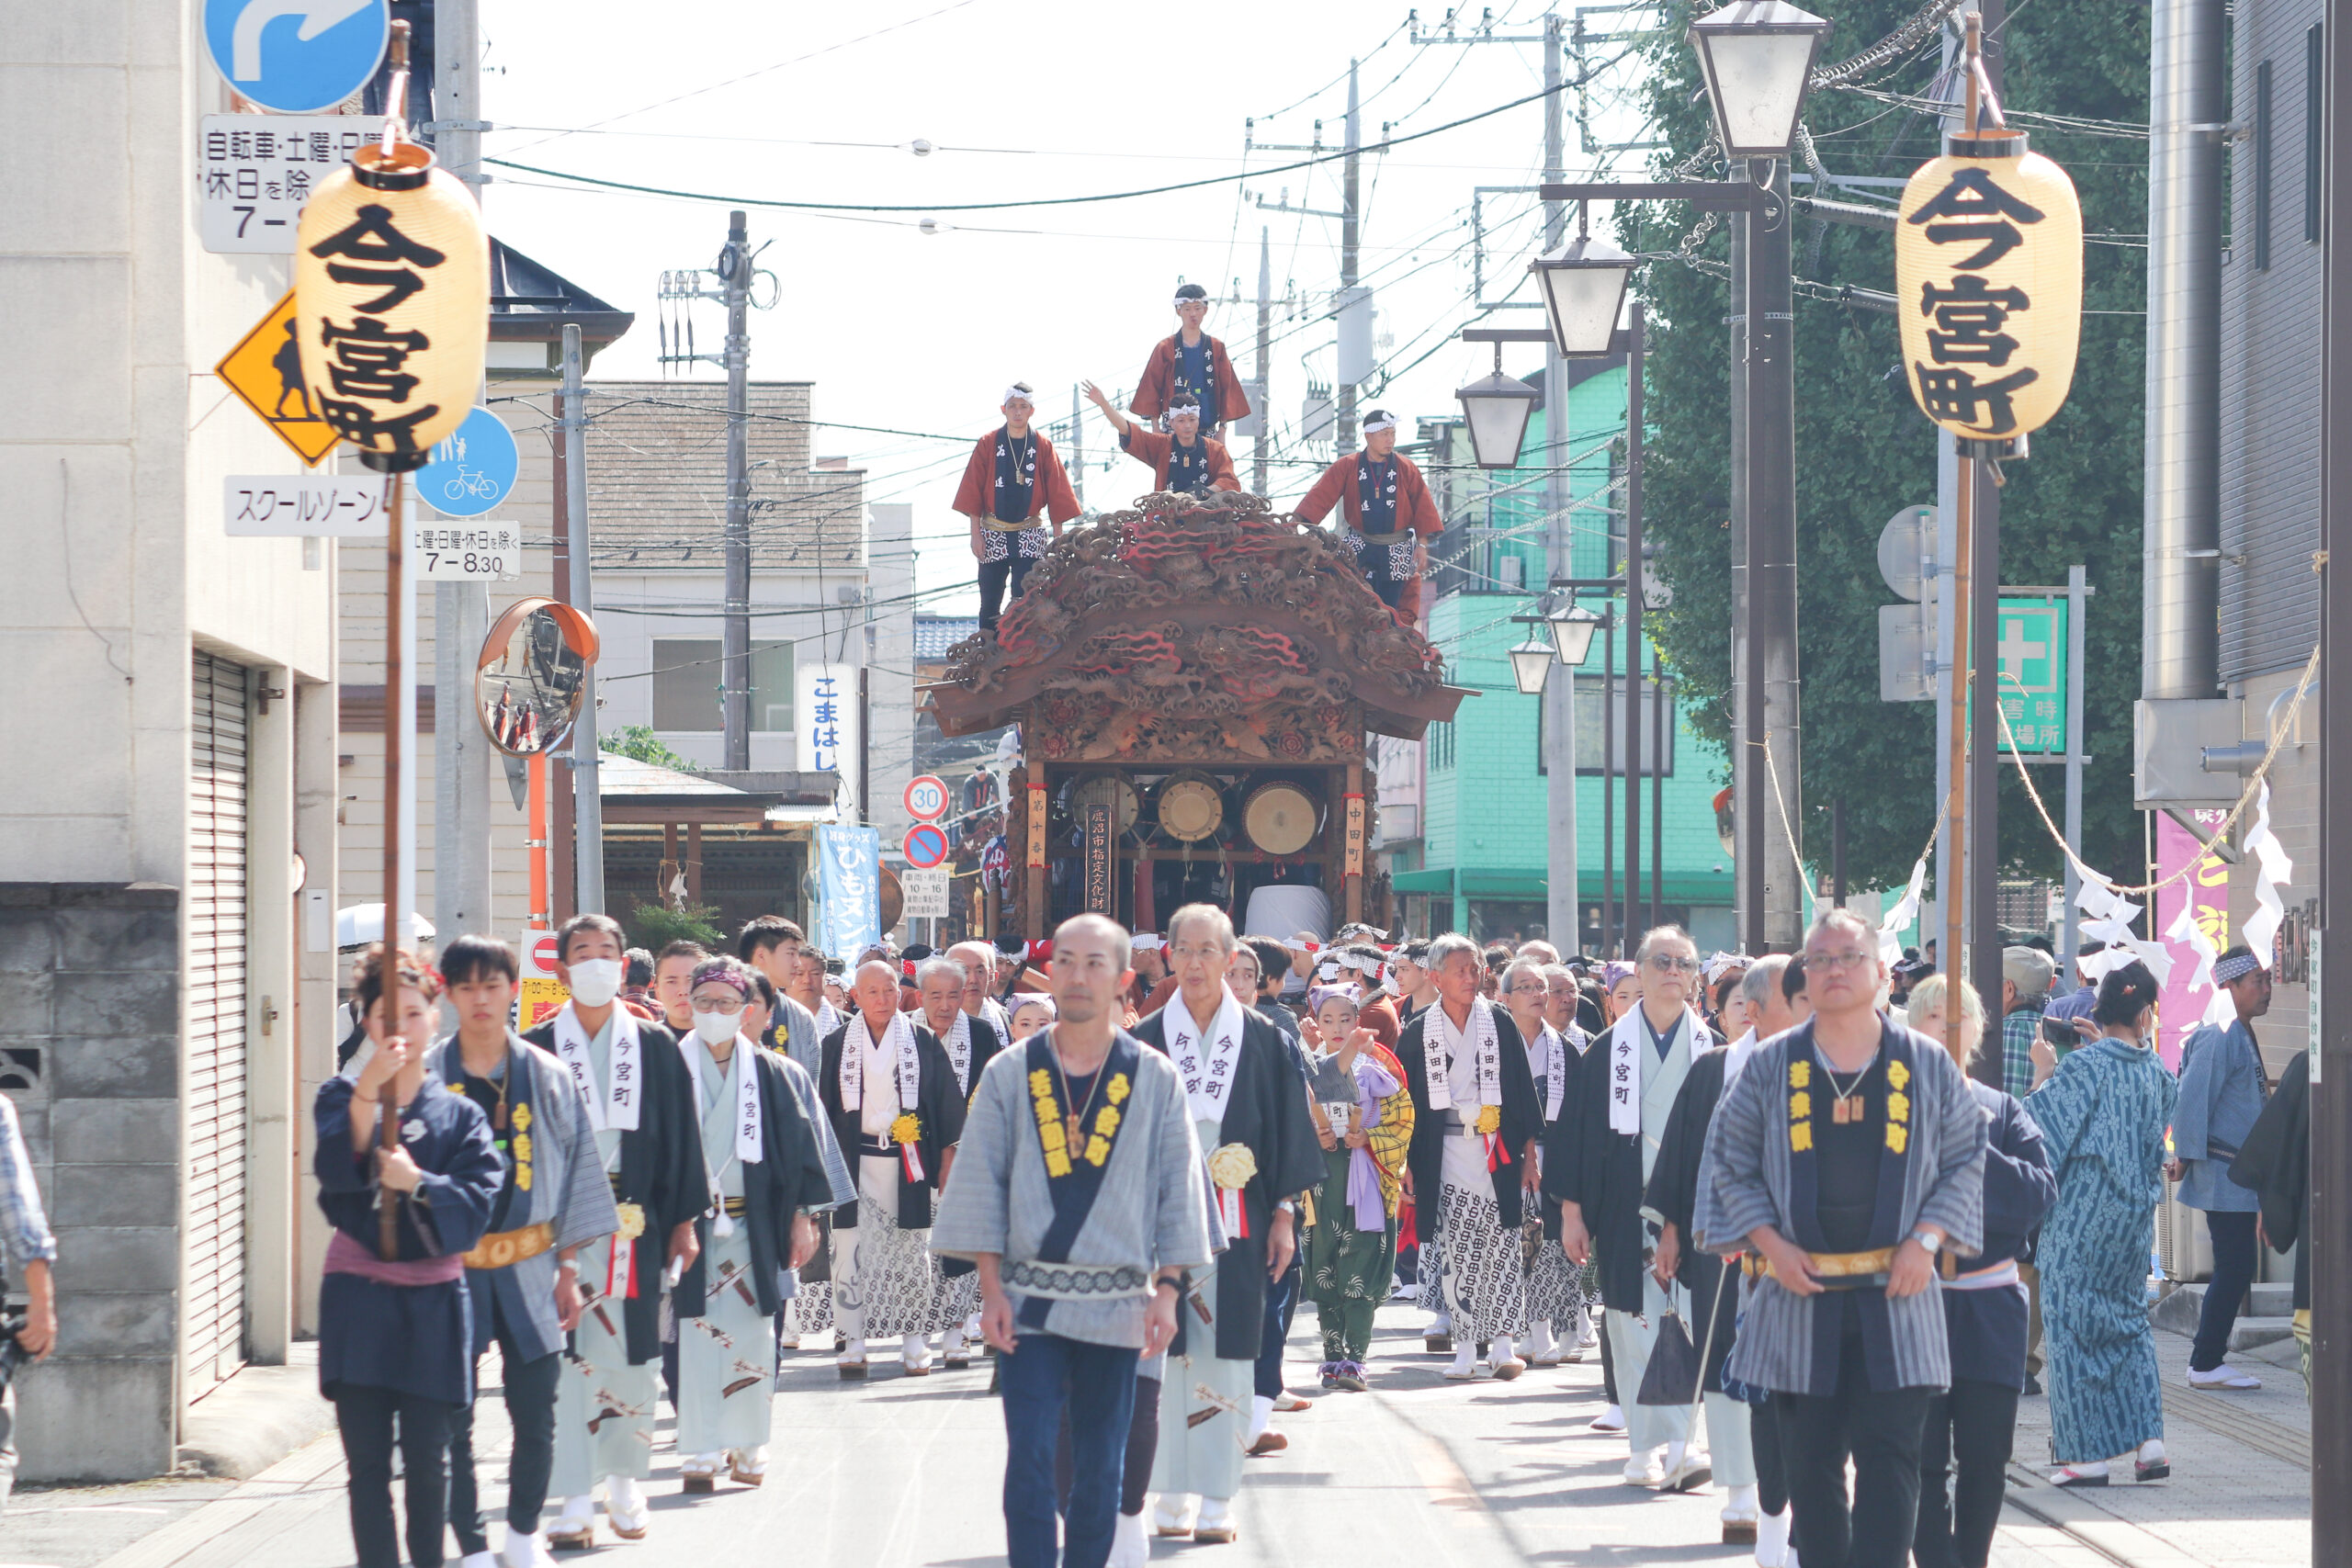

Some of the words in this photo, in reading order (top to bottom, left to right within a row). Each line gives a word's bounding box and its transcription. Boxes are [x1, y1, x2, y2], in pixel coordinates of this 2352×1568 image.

[207, 129, 383, 163] 自転車・土曜・日
[309, 203, 447, 455] 今宮町
[1906, 167, 2046, 434] 今宮町
[237, 490, 377, 522] スクールゾーン
[913, 788, 939, 808] 30
[1091, 809, 1106, 909] 鹿沼市指定文化財
[1348, 807, 1361, 862] 中田町
[614, 1036, 633, 1107] 今宮町
[904, 1046, 916, 1086] 中田町
[1175, 1032, 1203, 1095] 今宮町
[1205, 1034, 1235, 1100] 今宮町
[1428, 1038, 1443, 1083] 中田町
[1484, 1036, 1495, 1081] 中田町
[1615, 1040, 1633, 1106] 今宮町
[744, 1079, 757, 1140] 今宮町
[1083, 1072, 1131, 1168] 今宮町
[1332, 1105, 1342, 1118] 町
[1885, 1059, 1911, 1155] 今宮町
[511, 1101, 532, 1191] 今宮町
